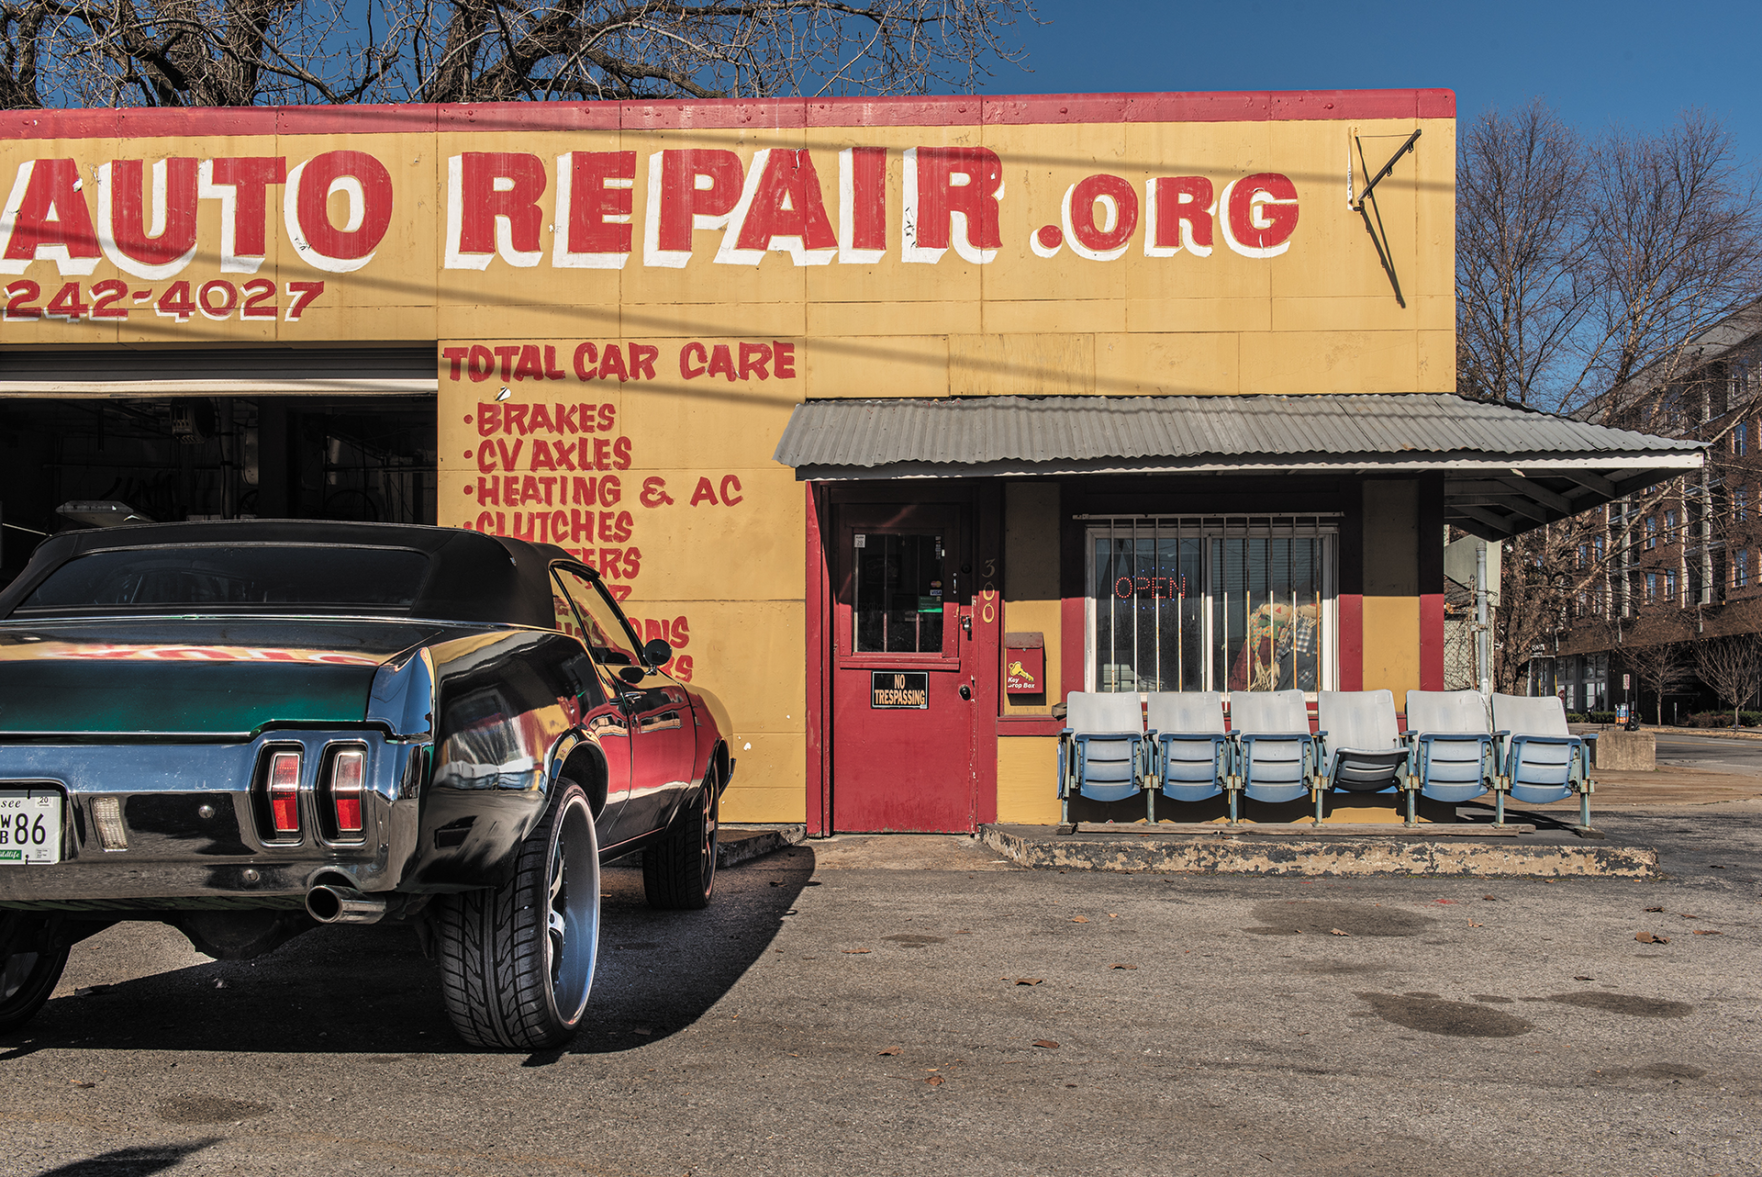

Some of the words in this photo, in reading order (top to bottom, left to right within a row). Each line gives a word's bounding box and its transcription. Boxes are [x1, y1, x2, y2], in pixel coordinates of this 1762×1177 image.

[0, 150, 393, 280] AUTO
[444, 147, 1005, 271] REPAIR
[3, 278, 325, 323] 242-4027
[443, 344, 566, 383] TOTAL
[573, 341, 659, 383] CAR
[680, 340, 796, 382] CARE
[477, 402, 617, 438] BRAKES
[477, 438, 523, 474] CV
[530, 436, 633, 473] AXLES
[476, 474, 622, 508] HEATING
[639, 475, 675, 509] &
[690, 474, 744, 507] AC
[475, 509, 635, 545] CLUTCHES
[981, 558, 996, 624] 300
[1115, 577, 1186, 600] OPEN
[874, 689, 926, 705] TRESPASSING
[893, 673, 906, 690] NO
[14, 813, 46, 845] 86
